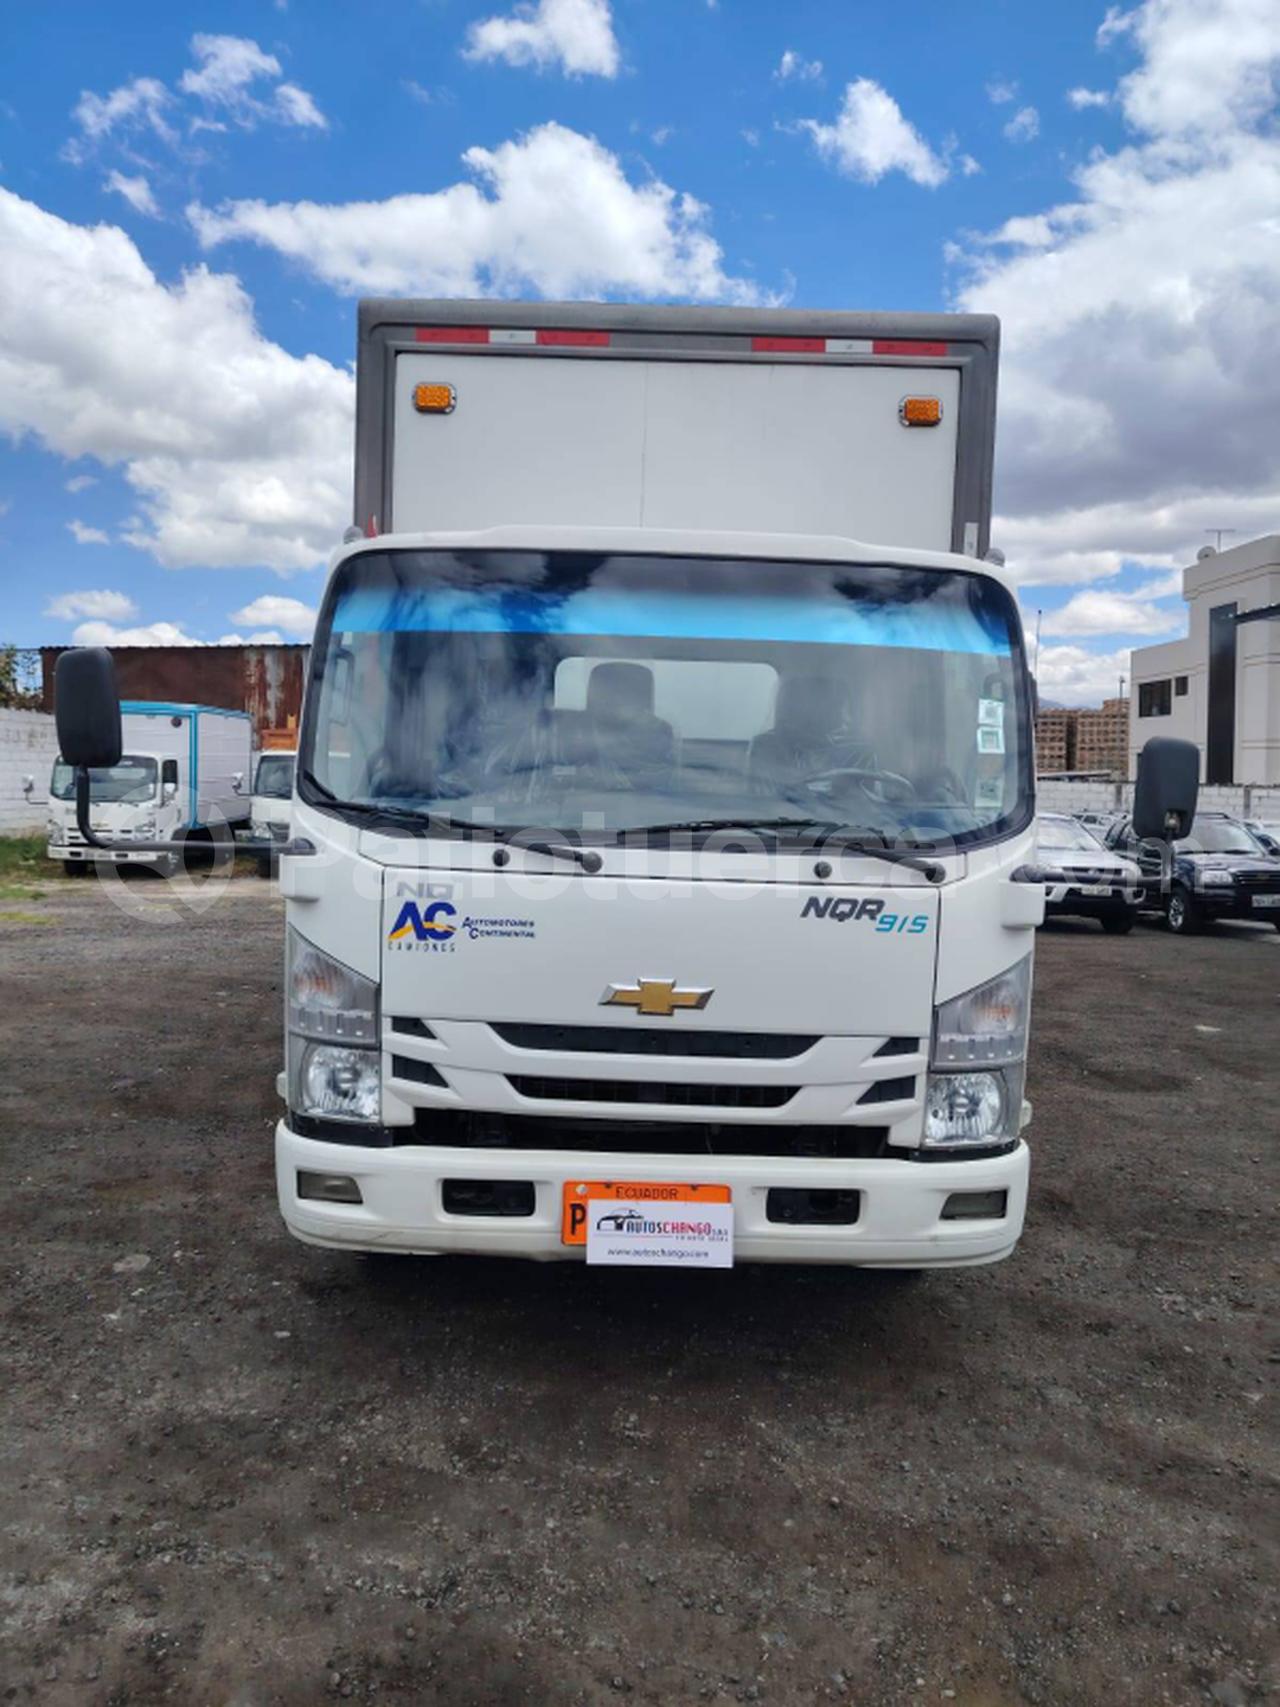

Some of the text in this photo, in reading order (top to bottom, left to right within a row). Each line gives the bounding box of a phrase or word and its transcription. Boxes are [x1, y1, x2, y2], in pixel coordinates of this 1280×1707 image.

[388, 901, 458, 941] AC
[800, 896, 886, 922] NQR
[615, 1185, 679, 1200] ECUADOR
